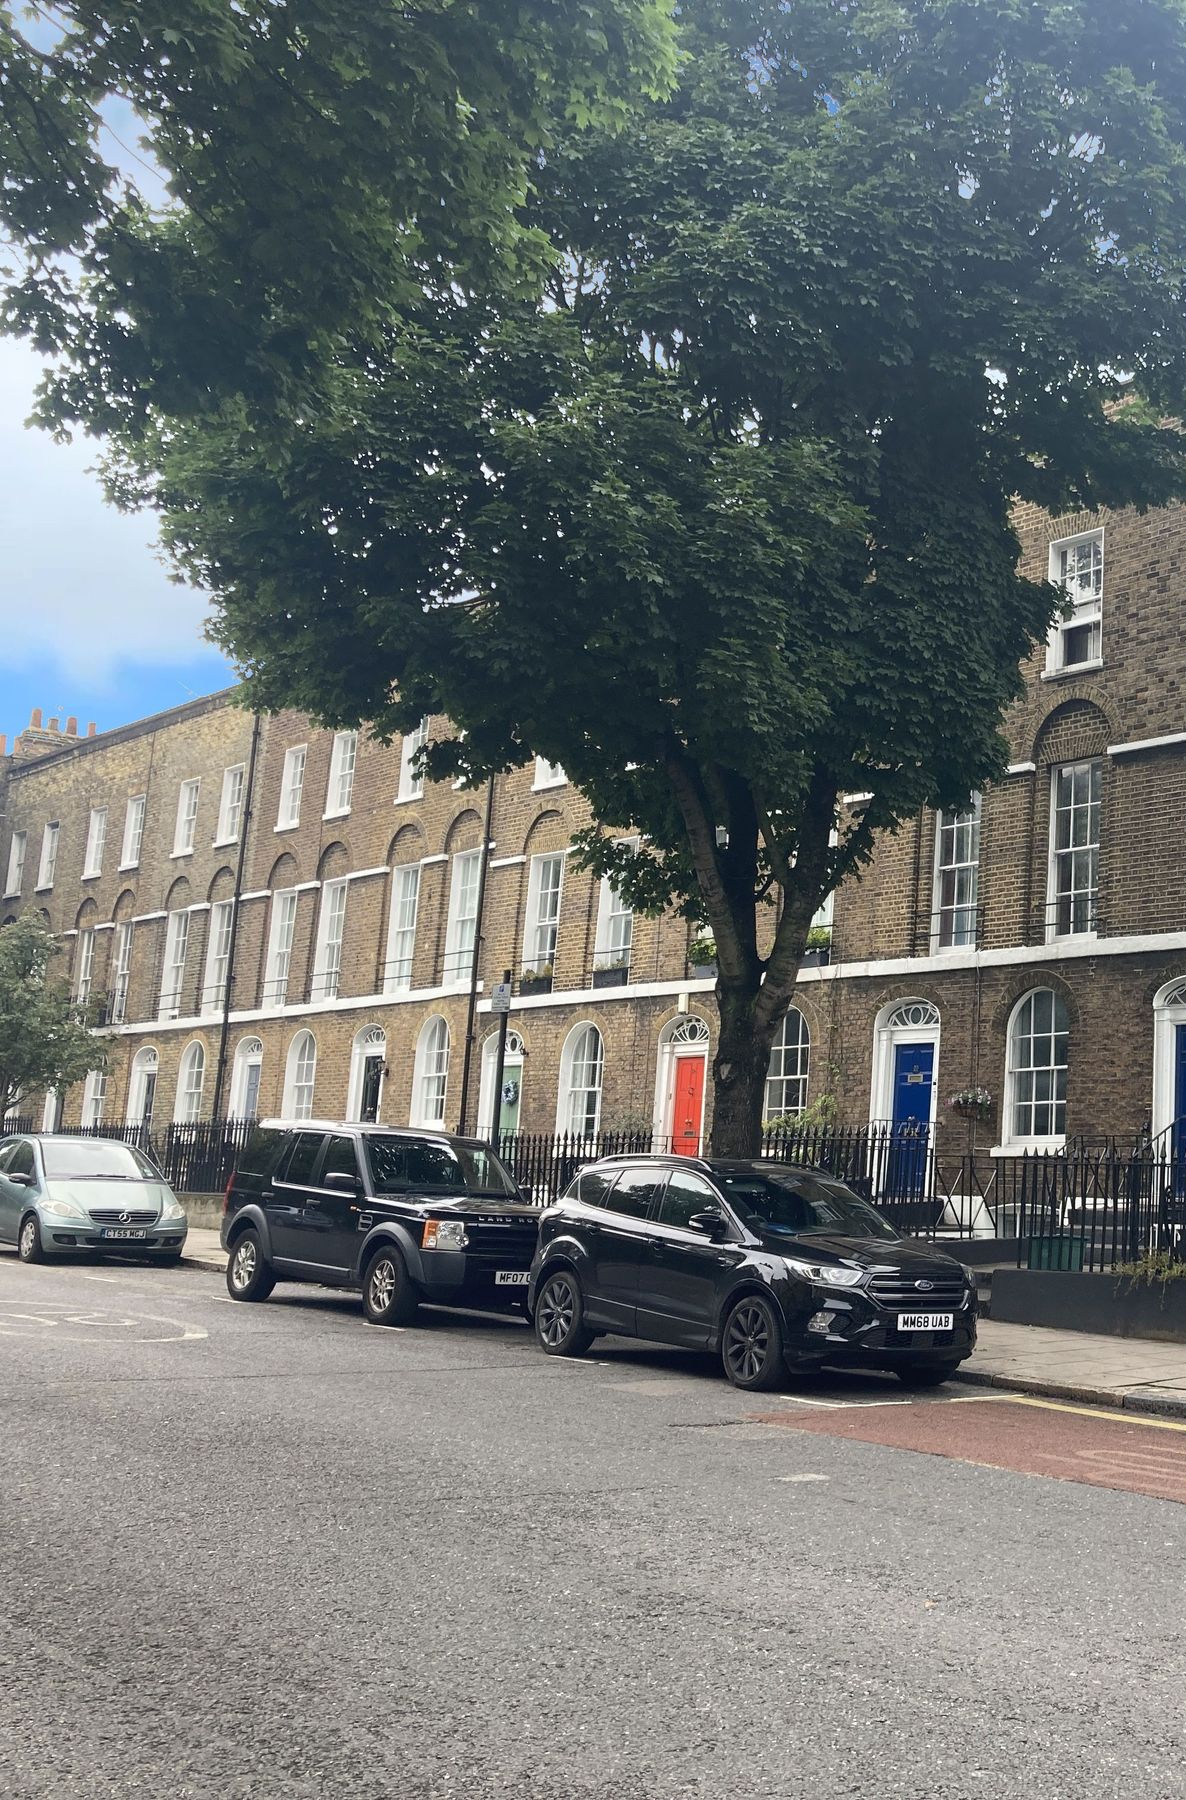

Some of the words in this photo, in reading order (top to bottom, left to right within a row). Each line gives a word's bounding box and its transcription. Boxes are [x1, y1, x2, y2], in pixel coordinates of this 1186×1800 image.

[106, 1229, 128, 1238] CT55
[499, 1273, 525, 1283] MF07
[902, 1315, 930, 1328] MM68
[931, 1315, 950, 1328] UAB
